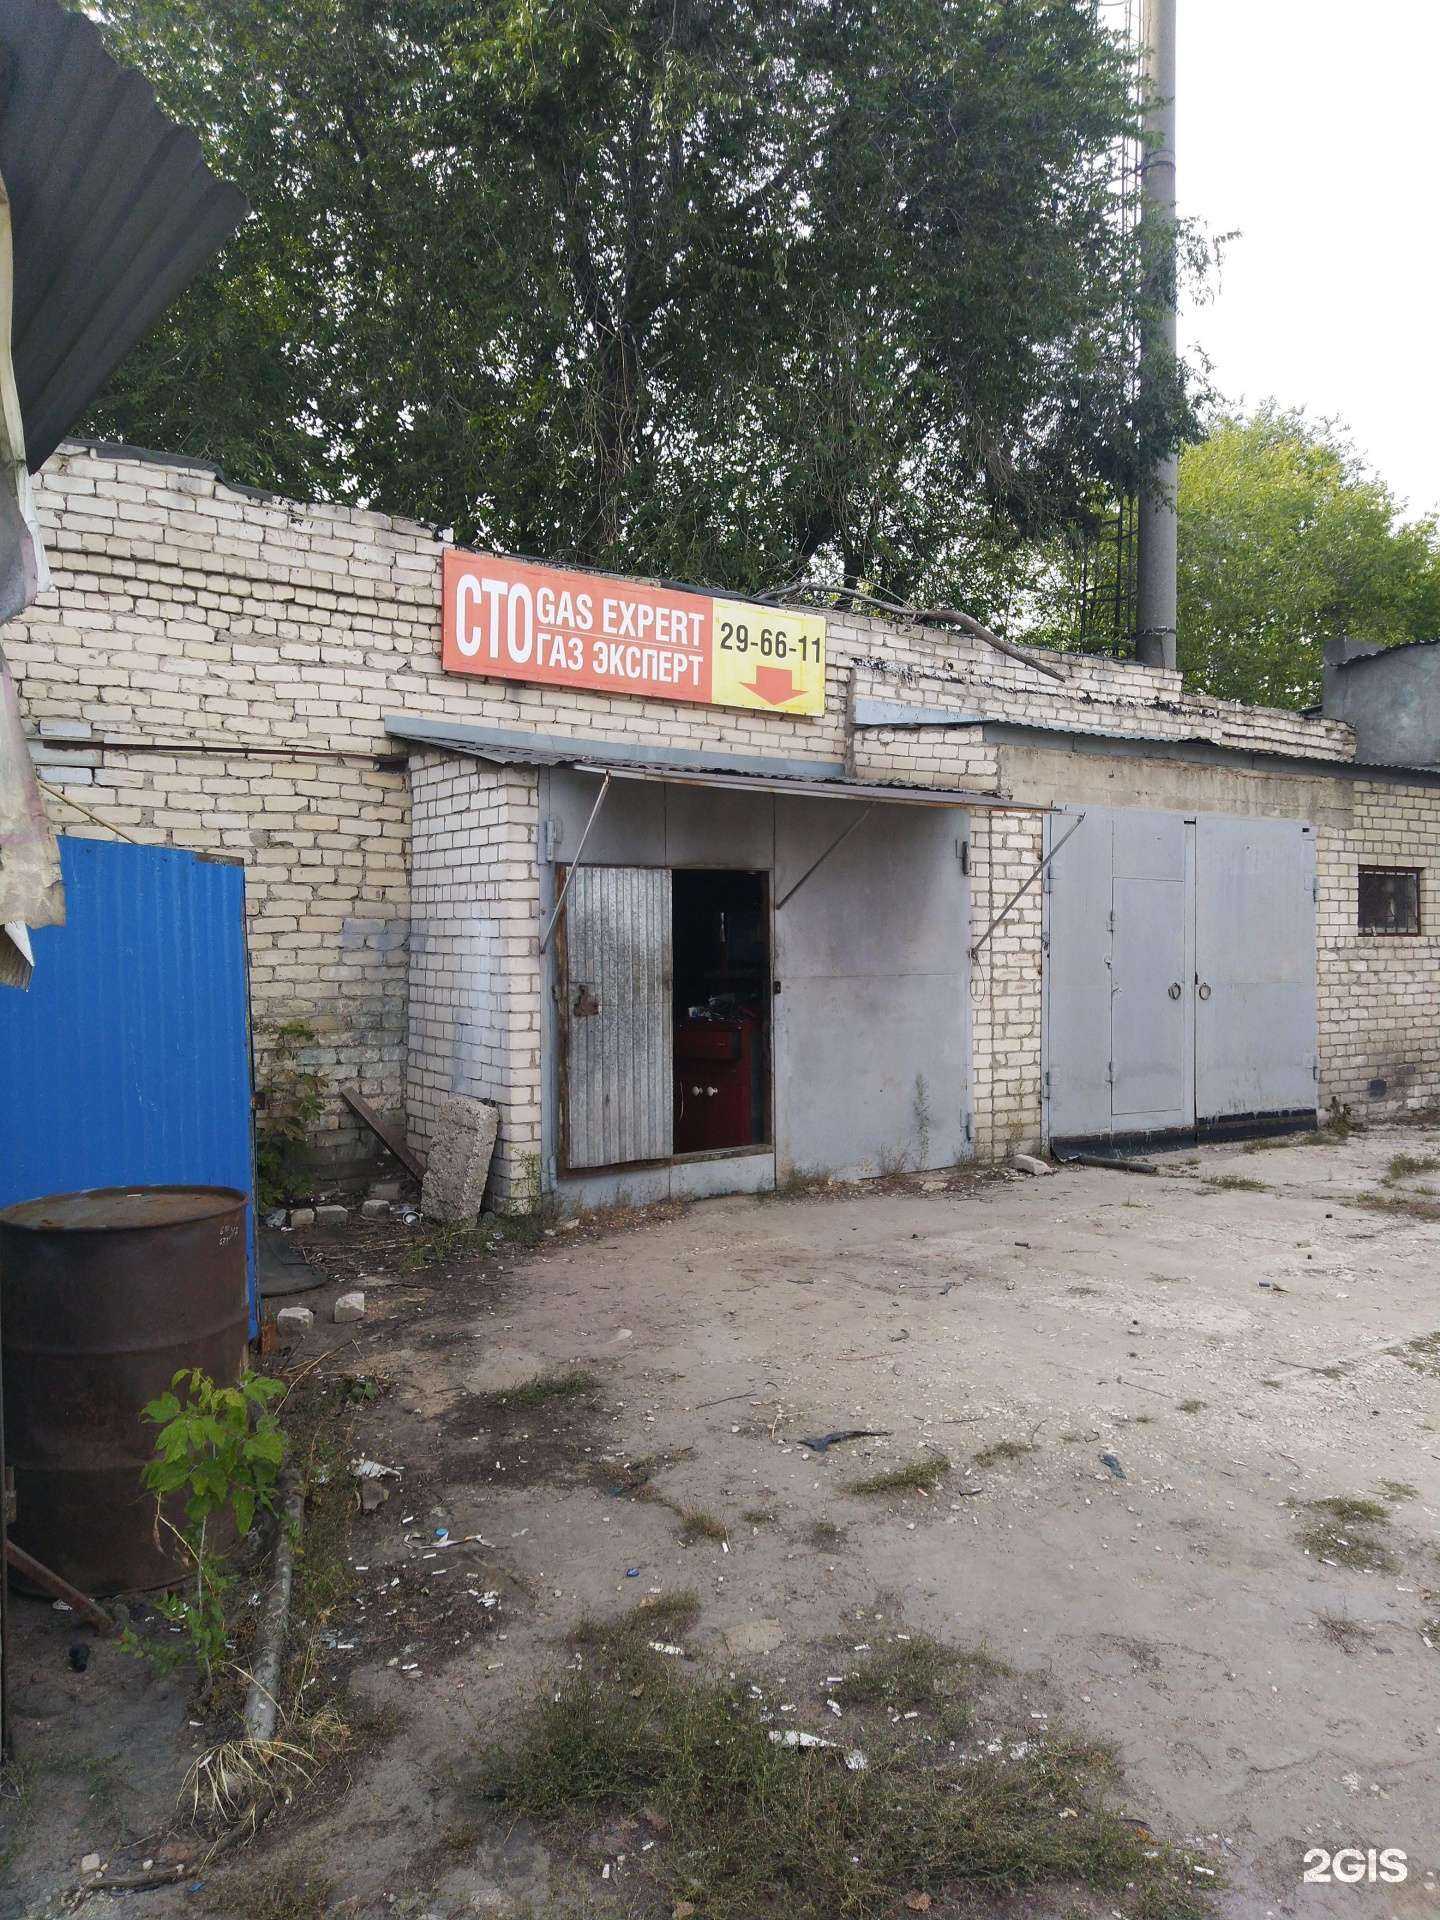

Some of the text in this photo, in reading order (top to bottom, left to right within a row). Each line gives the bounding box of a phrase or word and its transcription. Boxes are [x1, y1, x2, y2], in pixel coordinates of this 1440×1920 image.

[456, 574, 533, 663] СТО
[537, 587, 705, 647] GAS EXPERT
[720, 622, 821, 663] 29-66-11
[536, 633, 704, 686] ГАЗ ЭКСПЕРТ
